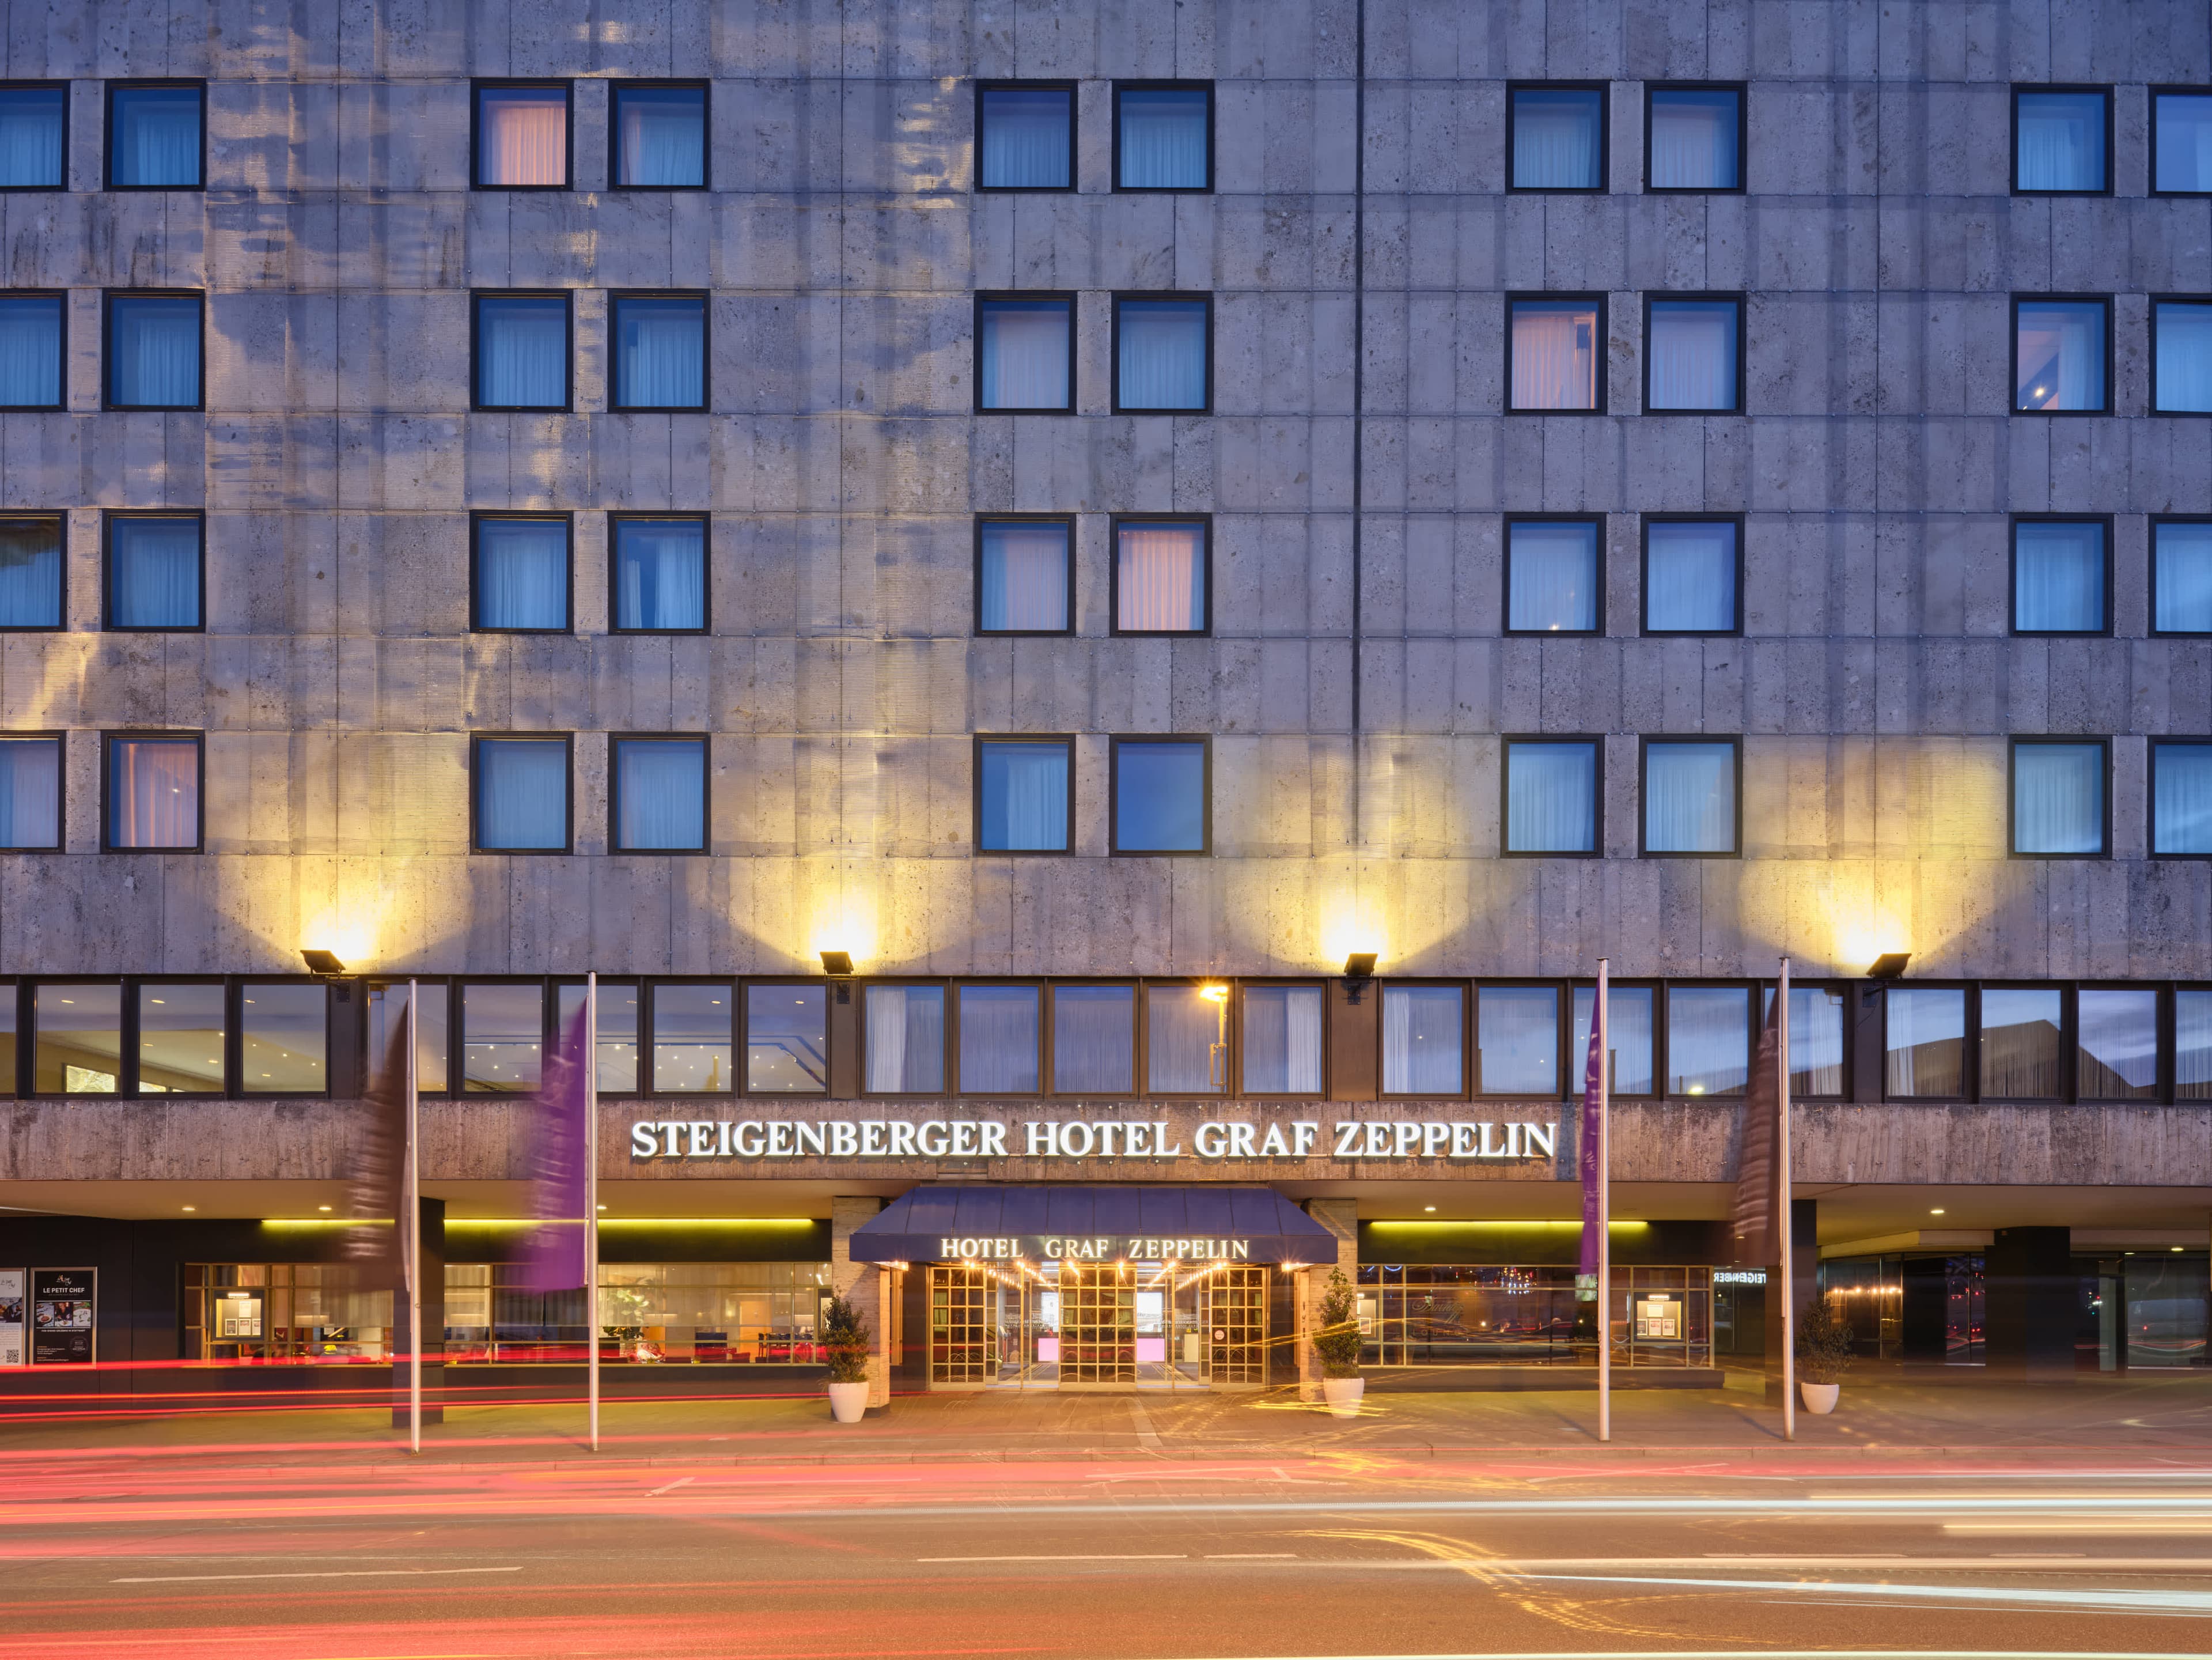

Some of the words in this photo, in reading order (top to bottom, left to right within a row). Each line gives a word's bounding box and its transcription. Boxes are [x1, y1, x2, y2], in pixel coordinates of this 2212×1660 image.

[631, 1120, 1009, 1157] STEIGENBERGER
[1024, 1121, 1180, 1157] HOTEL
[1195, 1121, 1319, 1157] GRAF
[1334, 1121, 1556, 1158] ZEPPELIN
[941, 1238, 1024, 1258] HOTEL
[1045, 1238, 1109, 1258] GRAF
[1129, 1239, 1249, 1259] ZEPPELIN
